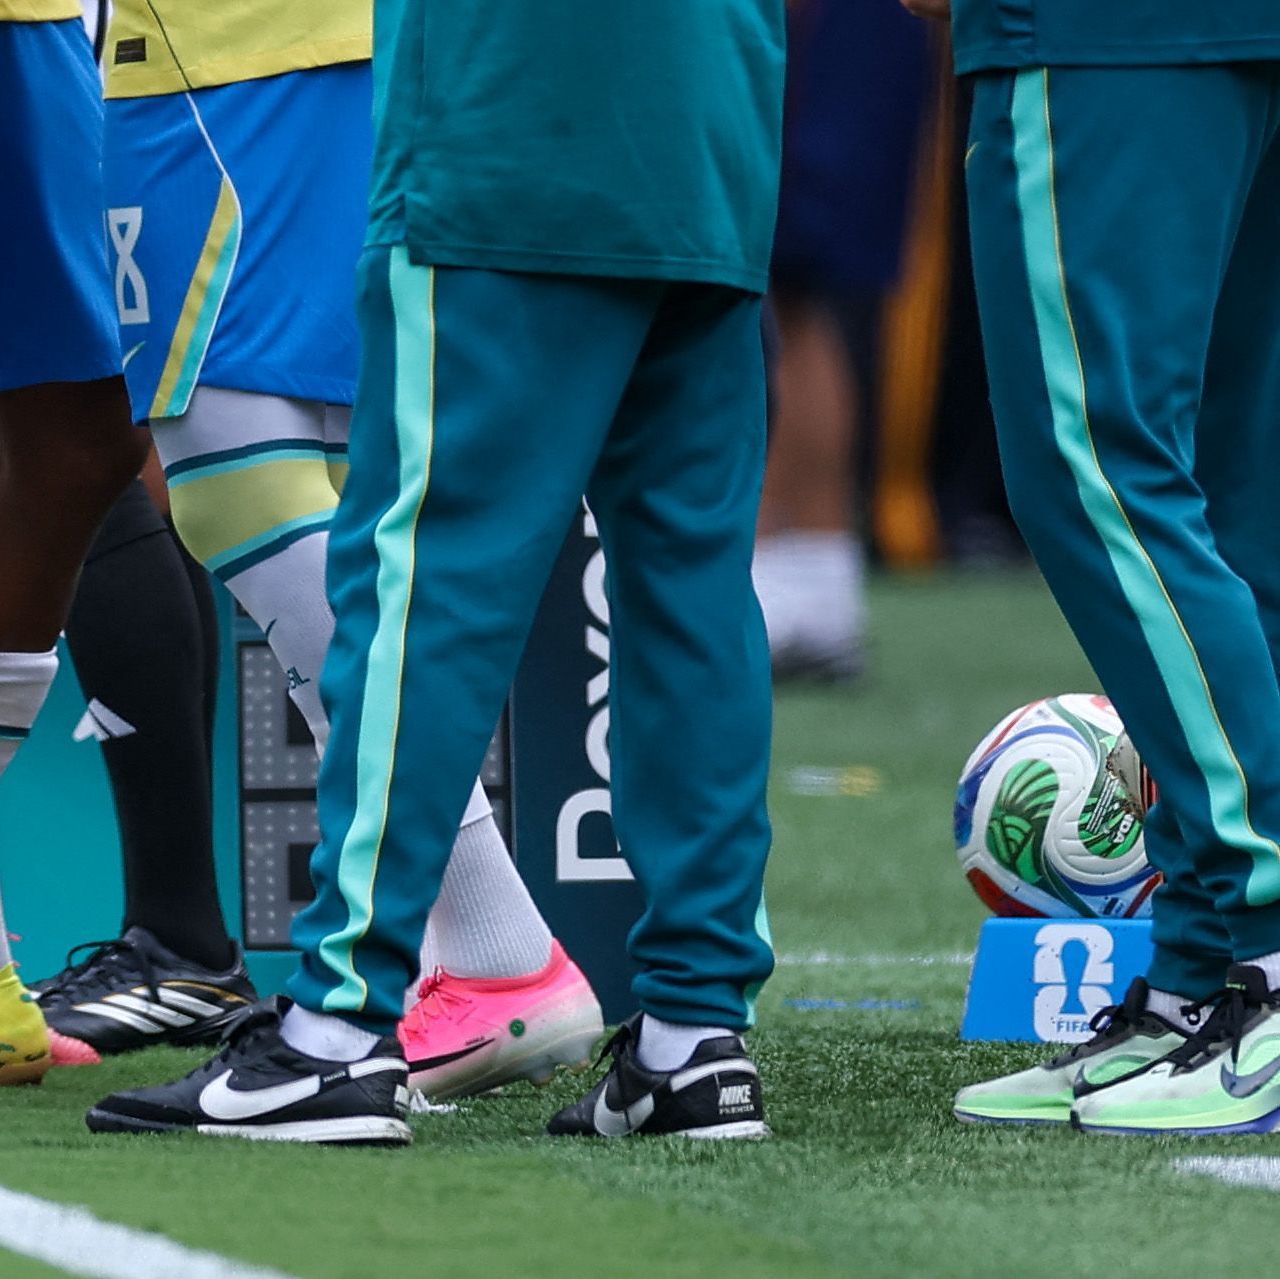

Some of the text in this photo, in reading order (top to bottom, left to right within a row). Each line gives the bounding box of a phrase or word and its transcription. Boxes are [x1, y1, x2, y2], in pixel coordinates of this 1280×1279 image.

[103, 206, 150, 325] 8
[1056, 1020, 1091, 1033] FIFA
[718, 1084, 752, 1107] NIKE
